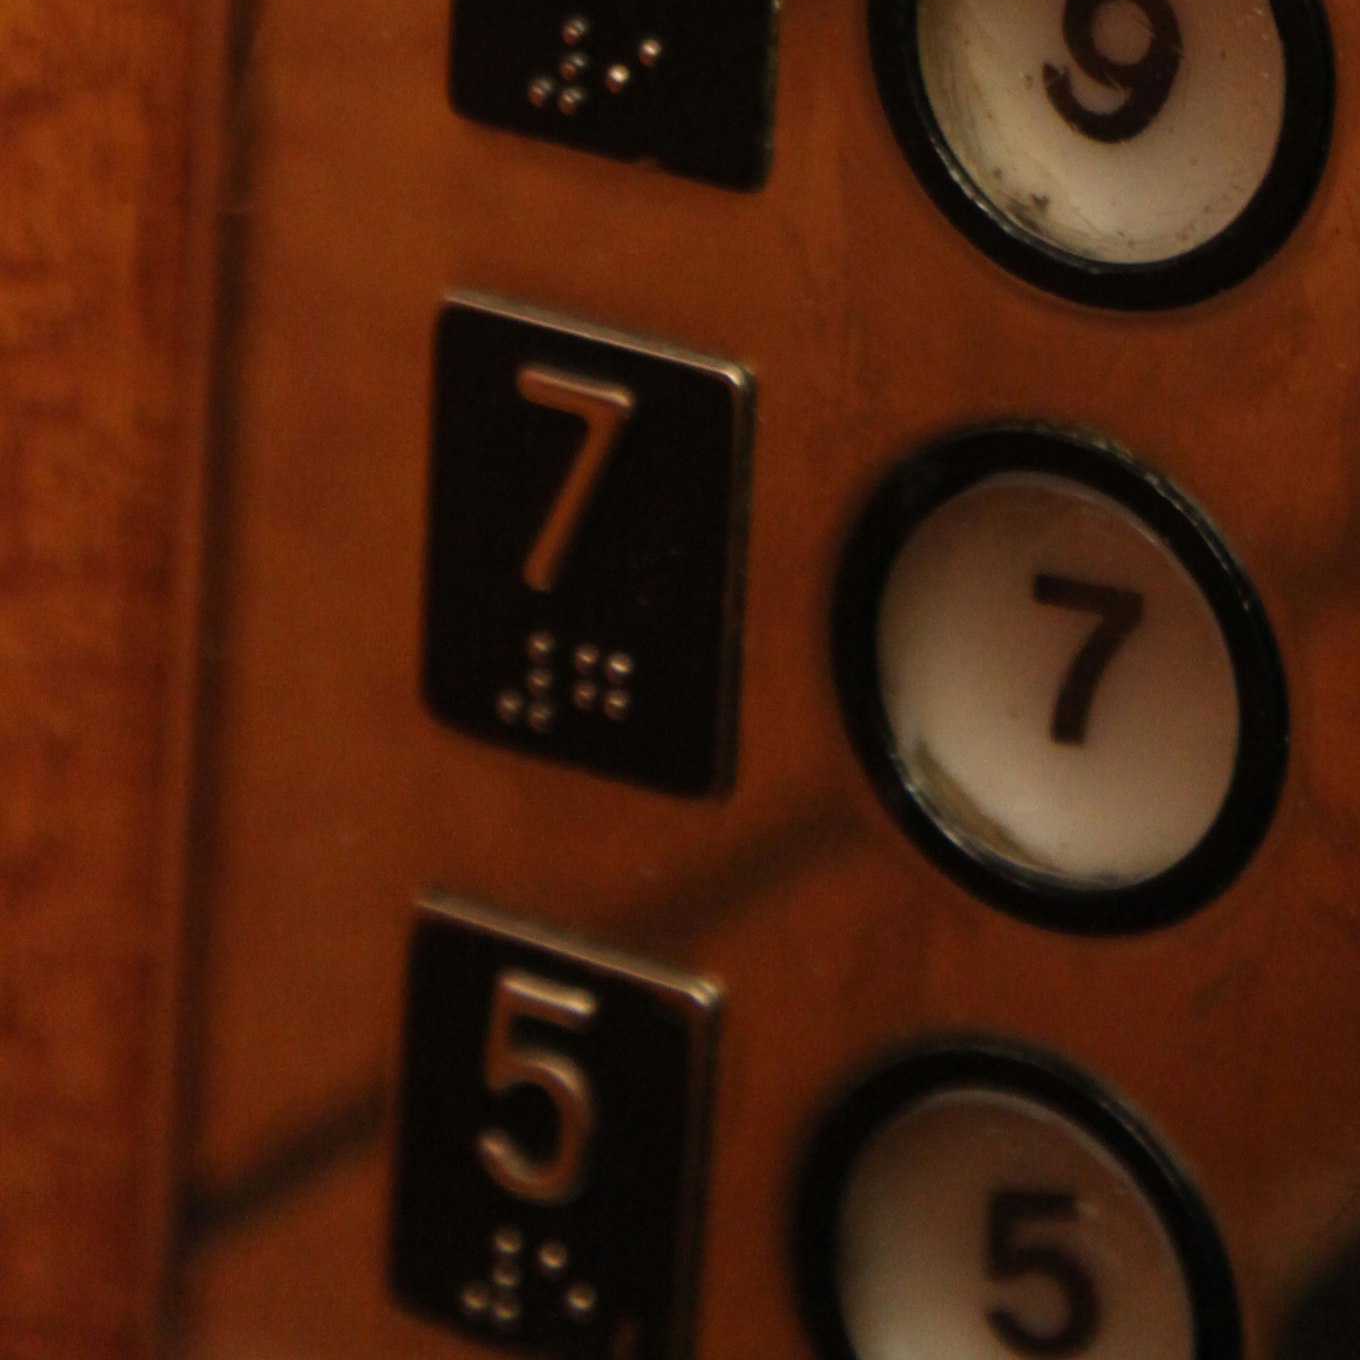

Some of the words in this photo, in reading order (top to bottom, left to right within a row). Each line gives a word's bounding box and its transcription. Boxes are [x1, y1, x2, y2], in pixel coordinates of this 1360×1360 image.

[516, 361, 634, 593] 7
[1032, 573, 1143, 747] 7
[478, 970, 597, 1203] 5
[985, 1185, 1102, 1356] 5
